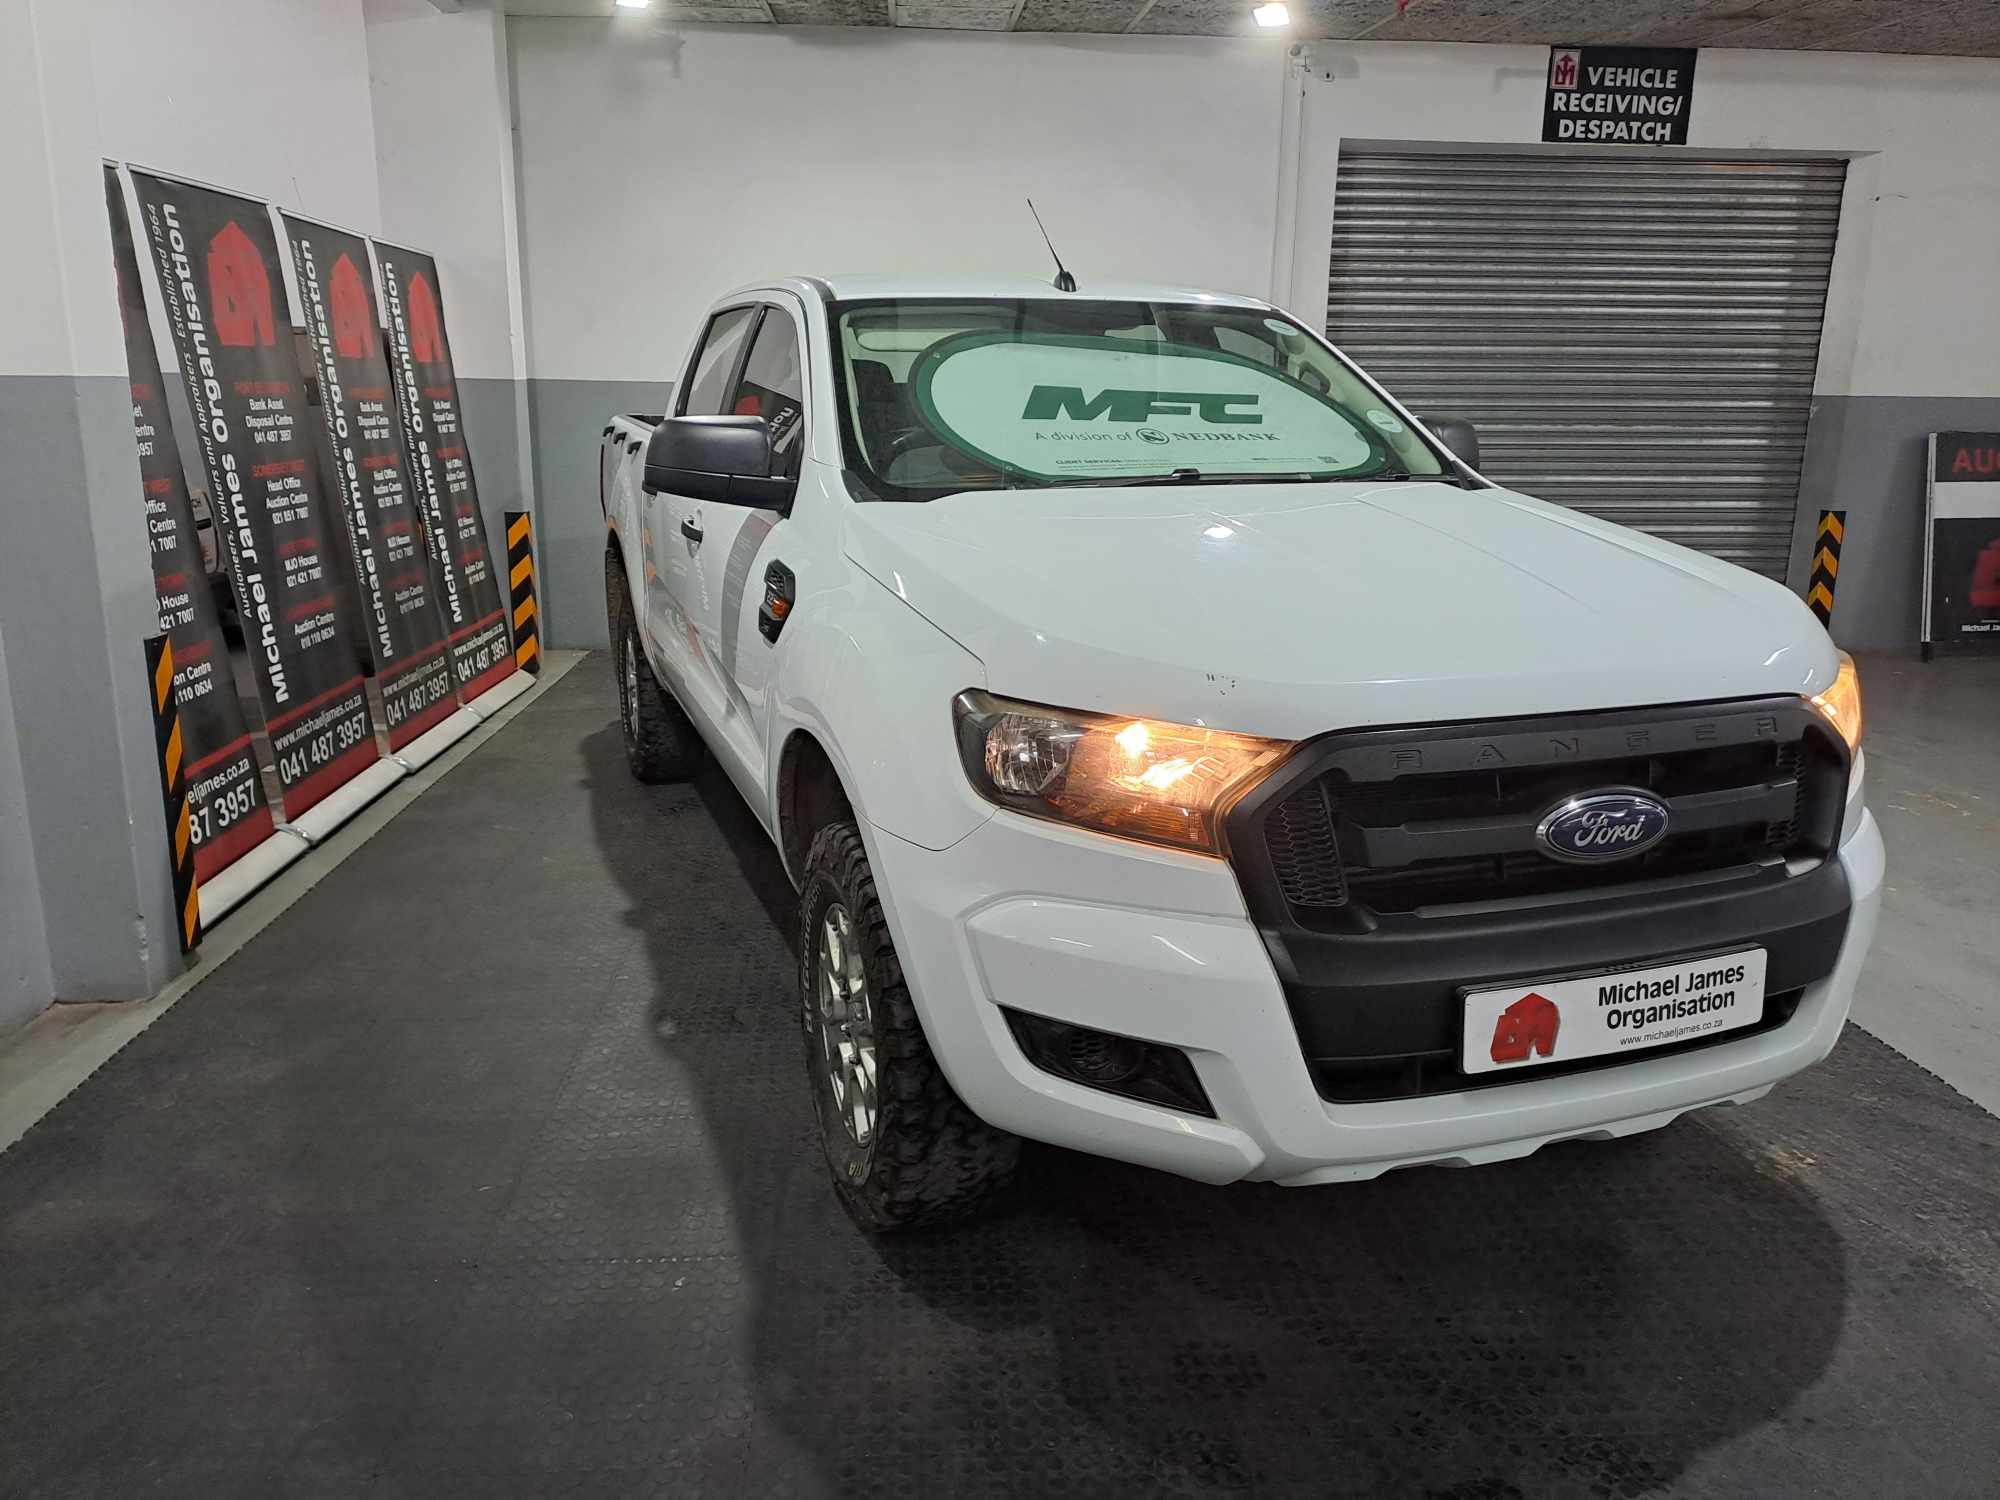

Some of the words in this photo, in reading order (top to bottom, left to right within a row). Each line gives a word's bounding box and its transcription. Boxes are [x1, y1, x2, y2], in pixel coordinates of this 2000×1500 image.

[1587, 66, 1678, 89] VEHICLE
[1553, 92, 1683, 116] RECEIVING/
[1558, 118, 1672, 142] DESPATCH
[147, 203, 164, 243] 1964
[157, 247, 186, 338] Established
[163, 203, 228, 443] Organisation
[301, 239, 348, 438] Organisation
[385, 262, 423, 433] Organisation
[183, 352, 208, 432] Appraisers
[1022, 385, 1262, 424] MFC
[135, 424, 155, 437] entre
[203, 435, 216, 465] and
[1035, 431, 1048, 441] A
[1051, 430, 1113, 441] division
[1119, 430, 1133, 441] of
[1173, 432, 1280, 442] NEDBANK
[211, 469, 230, 524] Valuers
[343, 447, 370, 541] James
[419, 440, 442, 521] James
[149, 518, 177, 533] Centre
[221, 453, 258, 564] James
[158, 535, 177, 552] 7007
[226, 530, 252, 618] Auctioneers,
[434, 527, 462, 623] Michael
[161, 592, 189, 610] House
[176, 607, 195, 625] 7007
[362, 548, 393, 658] Michael
[247, 574, 289, 703] Michael
[457, 655, 476, 681] 041
[476, 646, 490, 671] 487
[490, 635, 508, 662] 3957
[186, 661, 212, 680] Centre
[194, 678, 213, 697] 0634
[386, 695, 407, 726] 041
[409, 684, 426, 712] 487
[426, 670, 449, 701] 3957
[274, 694, 362, 751] www.michaeljames.co.za
[1391, 717, 1777, 769] RANGER
[280, 747, 308, 785] 041
[311, 730, 334, 764] 487
[336, 711, 366, 749] 3957
[187, 758, 250, 804] eljames.co.za
[189, 806, 211, 845] 87
[214, 777, 256, 827] 3957
[1574, 808, 1645, 848] Ford
[1598, 974, 1680, 1007] Michael
[1685, 965, 1745, 993] James
[1606, 990, 1735, 1030] Organisation
[1619, 1019, 1723, 1045] www.michaeljames.co.za
